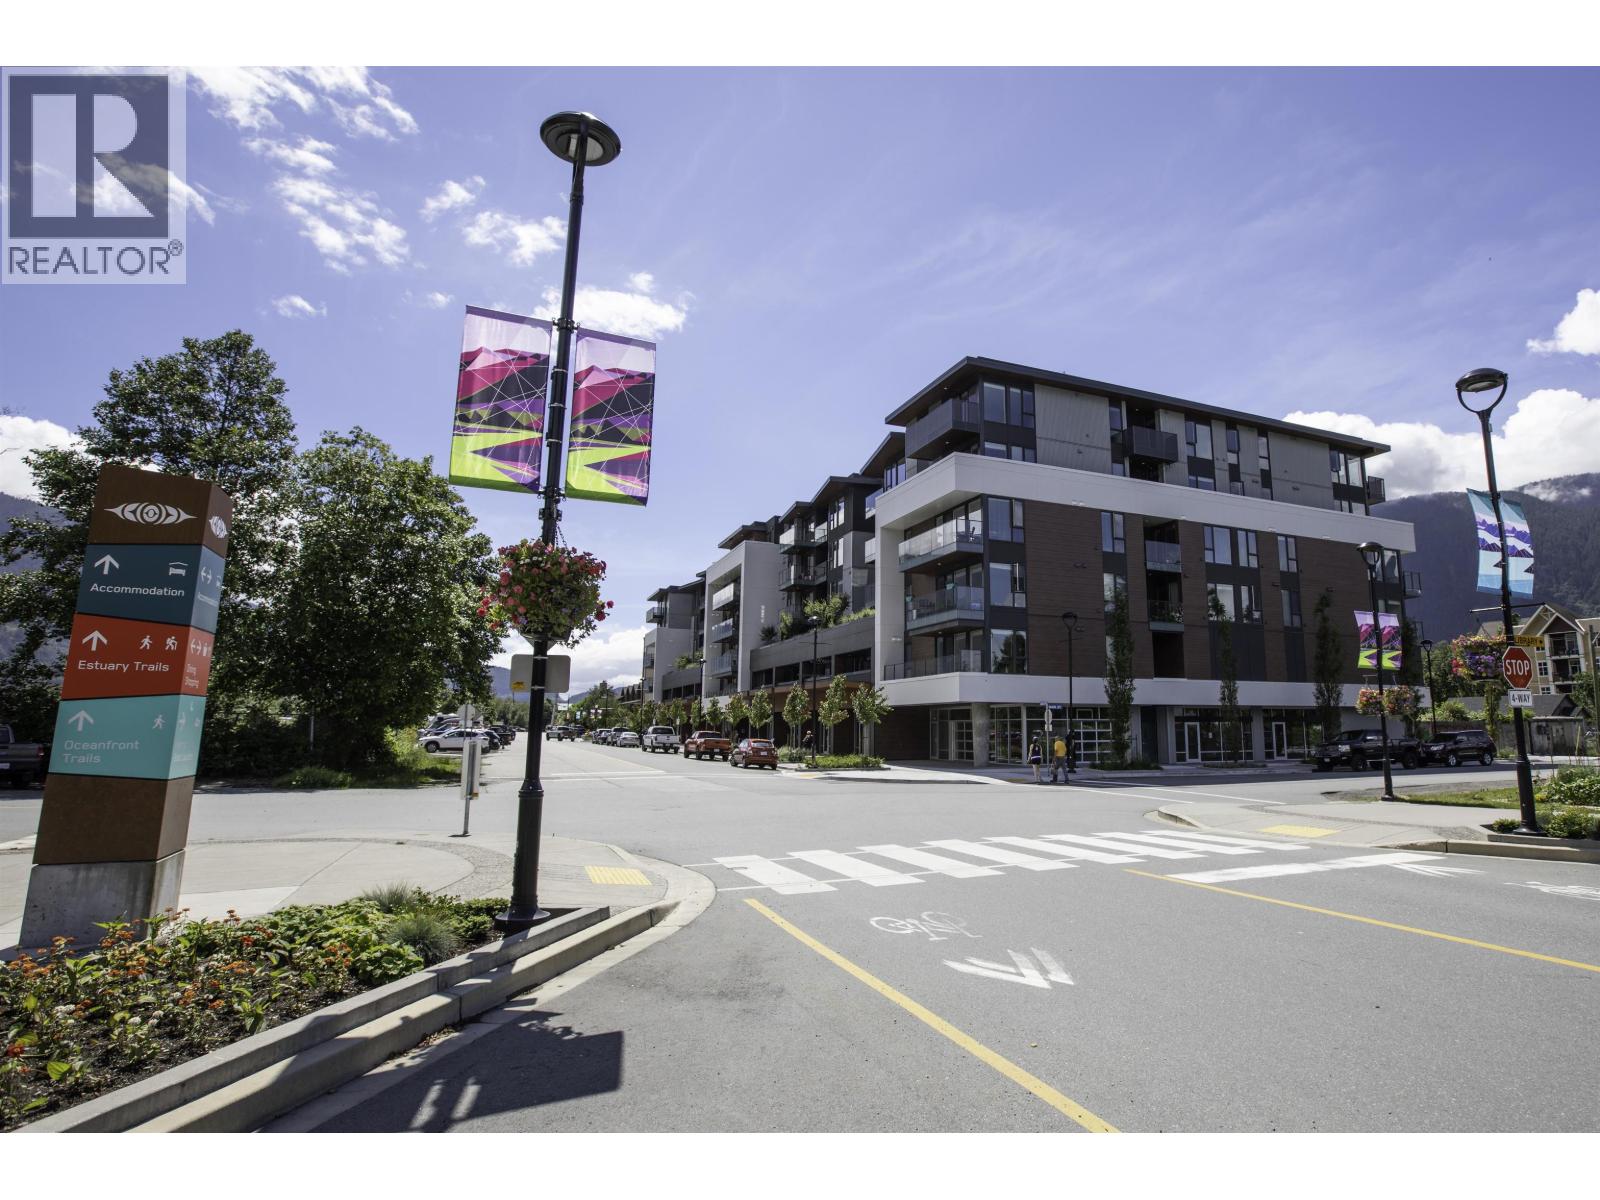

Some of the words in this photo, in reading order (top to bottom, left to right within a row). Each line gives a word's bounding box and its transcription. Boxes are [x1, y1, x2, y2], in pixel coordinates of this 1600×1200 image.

[90, 583, 185, 597] Accommodation
[78, 660, 130, 673] Estuary
[133, 661, 170, 672] Trails
[1505, 659, 1530, 676] STOP
[1511, 693, 1530, 703] 4-WAY
[64, 740, 140, 751] Oceanfront
[63, 753, 102, 764] Trails
